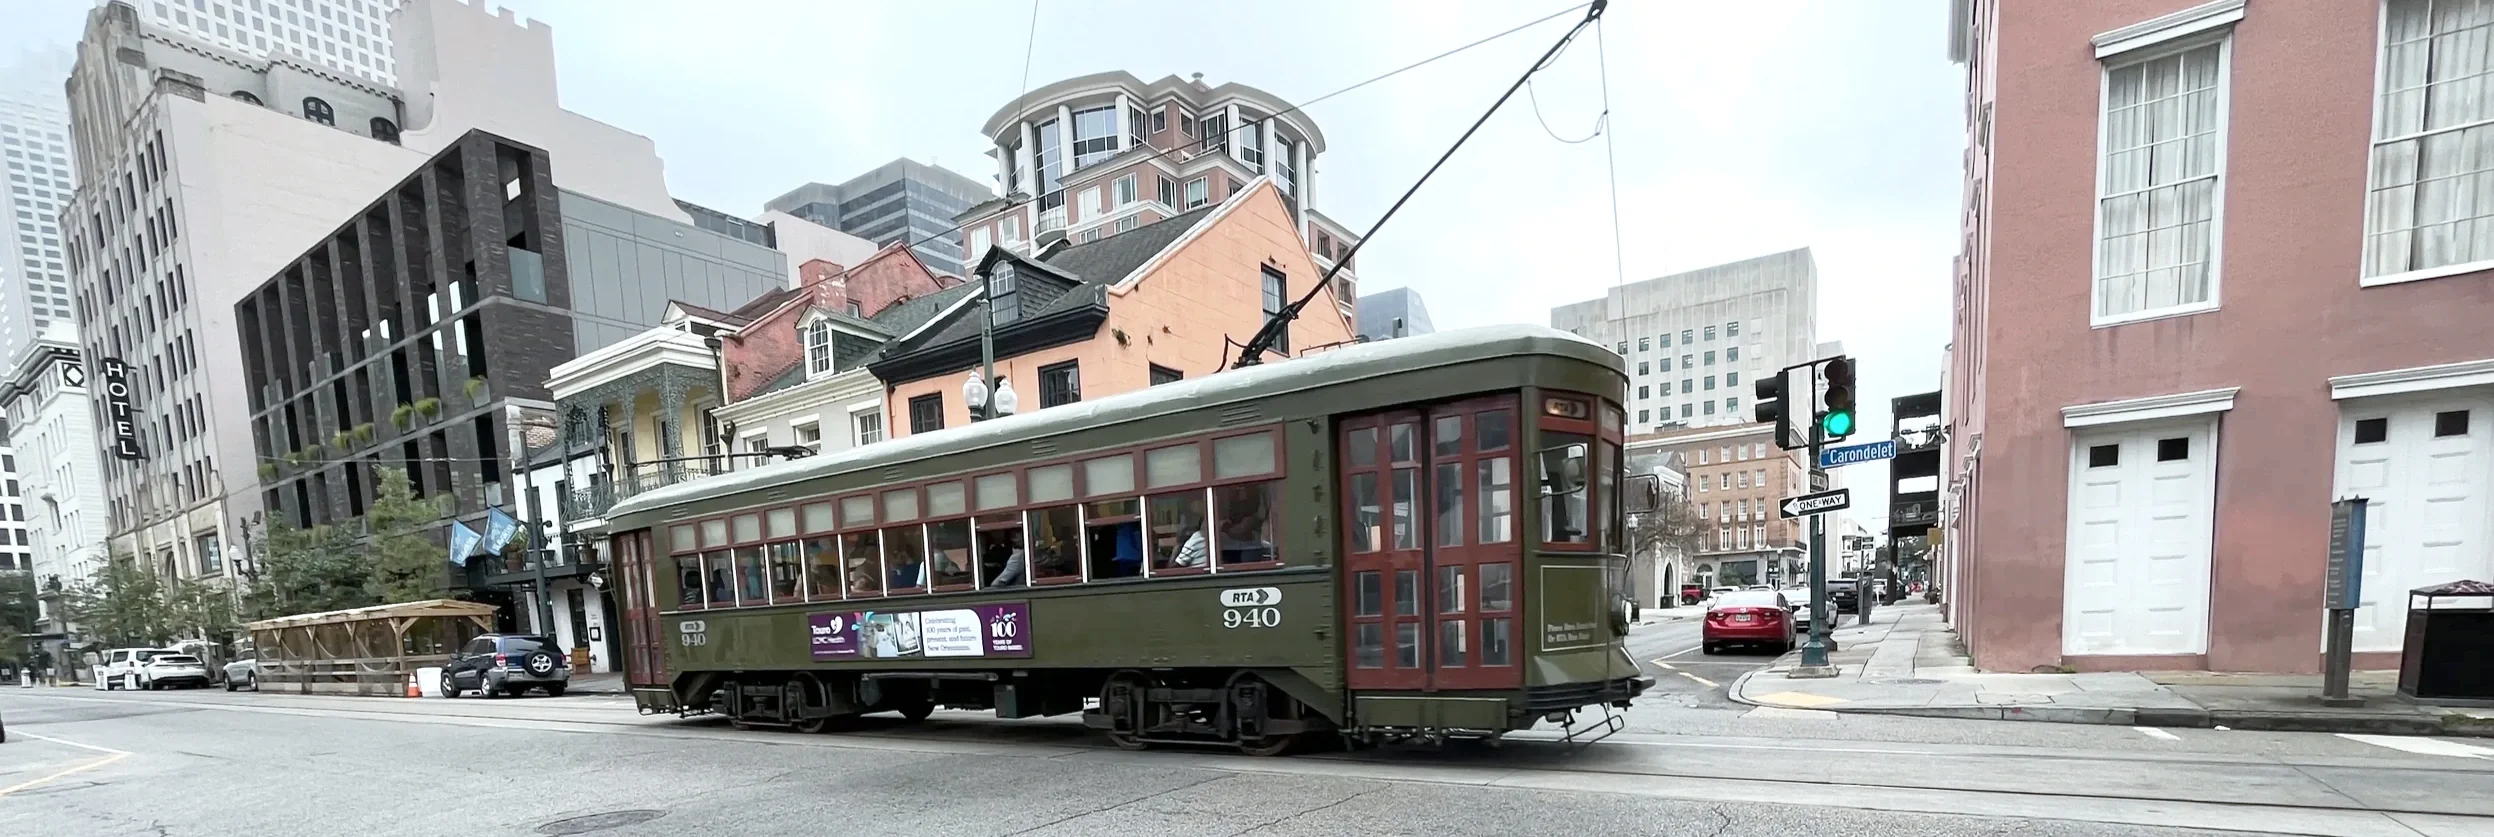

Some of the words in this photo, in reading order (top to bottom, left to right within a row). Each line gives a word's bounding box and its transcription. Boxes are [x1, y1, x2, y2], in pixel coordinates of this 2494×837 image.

[106, 362, 136, 455] HOTEL
[1830, 443, 1893, 464] Carondelet
[1800, 499, 1819, 510] ONE
[1822, 495, 1842, 507] WAY
[1233, 592, 1254, 603] RTA
[1223, 607, 1281, 628] 940
[990, 621, 1017, 638] 100
[682, 633, 706, 647] 940
